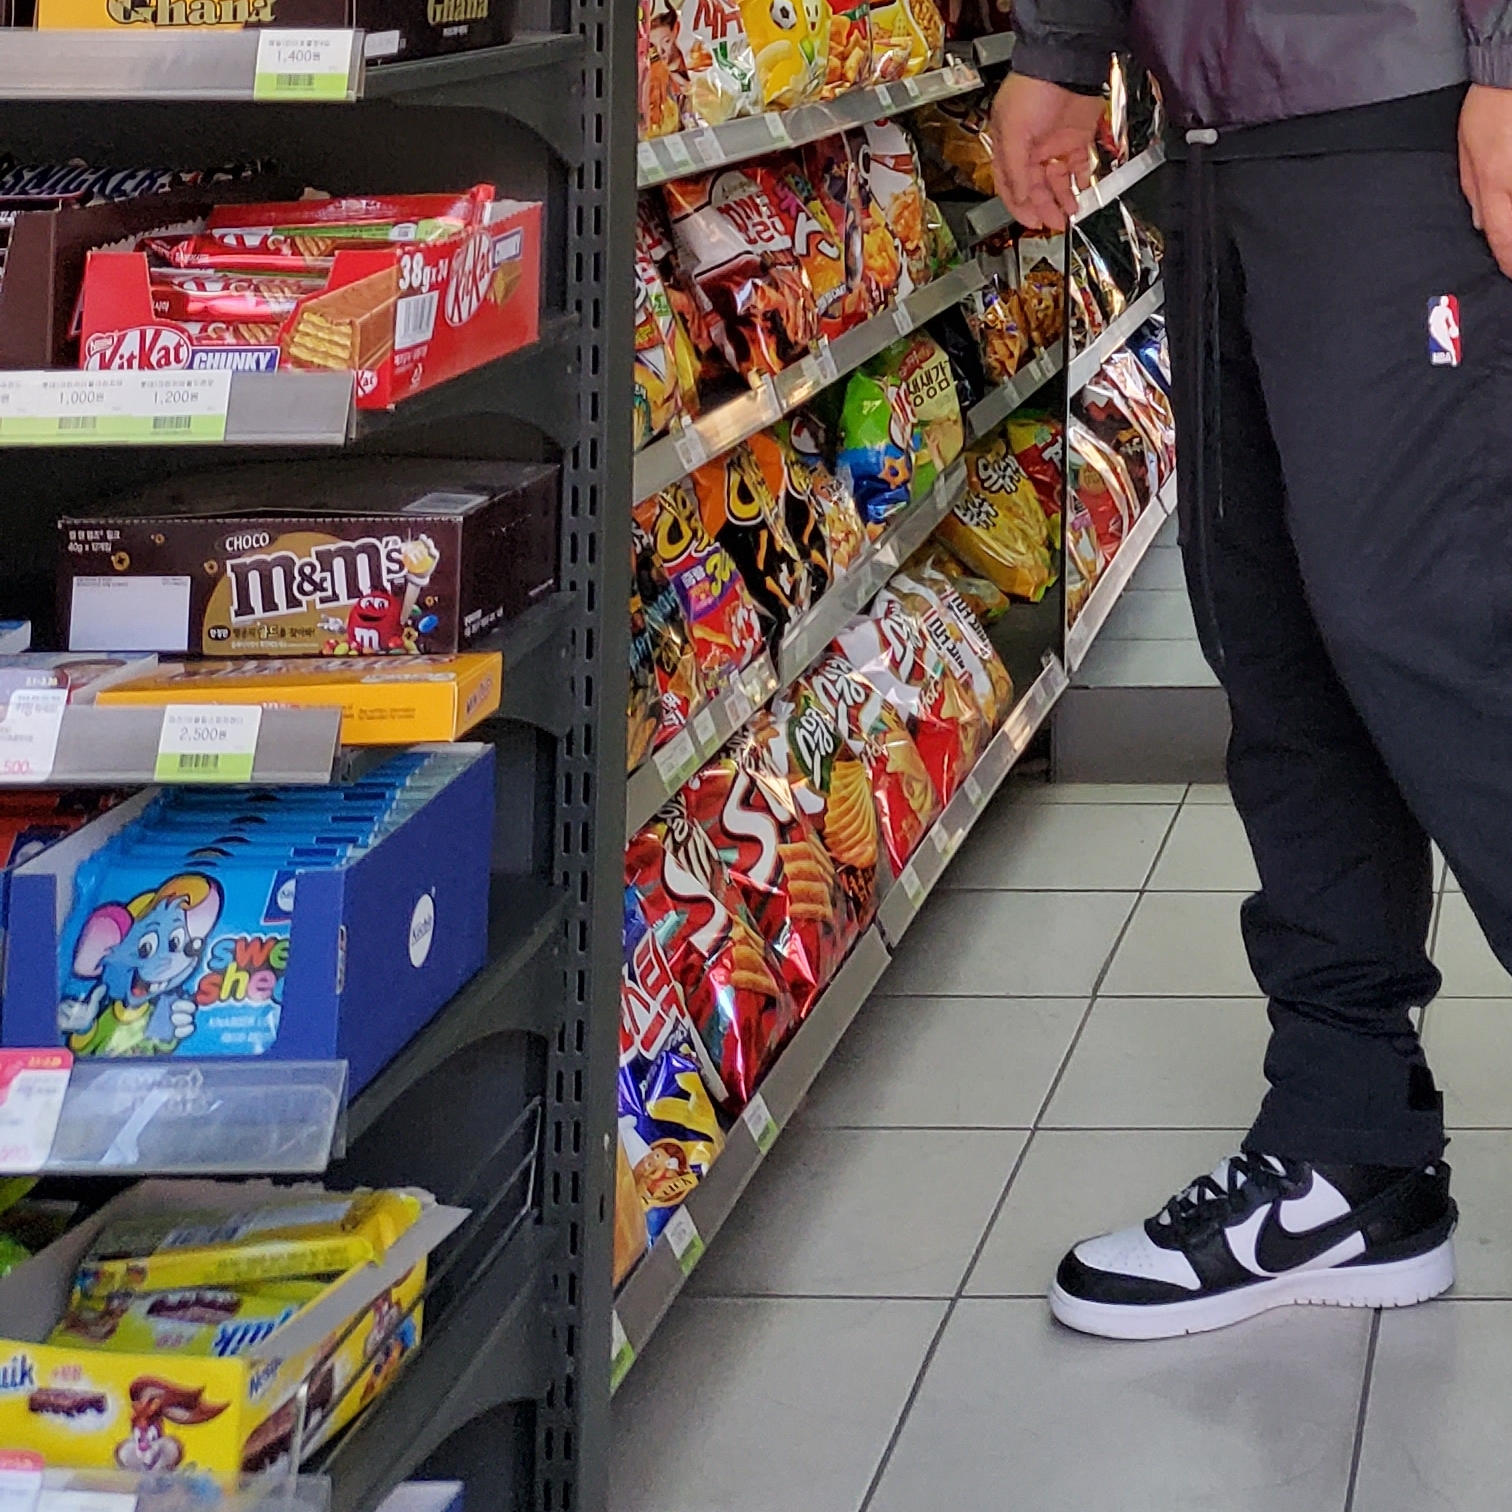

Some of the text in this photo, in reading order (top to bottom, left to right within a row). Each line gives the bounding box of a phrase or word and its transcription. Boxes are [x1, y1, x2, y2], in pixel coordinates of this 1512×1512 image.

[277, 50, 321, 62] 1,400원
[92, 329, 186, 371] KitKat
[193, 350, 272, 371] CHUNKY
[59, 391, 104, 404] 1,000원
[153, 391, 199, 403] 1,200원
[224, 532, 270, 551] CHOCO
[179, 727, 227, 741] 2,500원
[209, 938, 289, 970] swe
